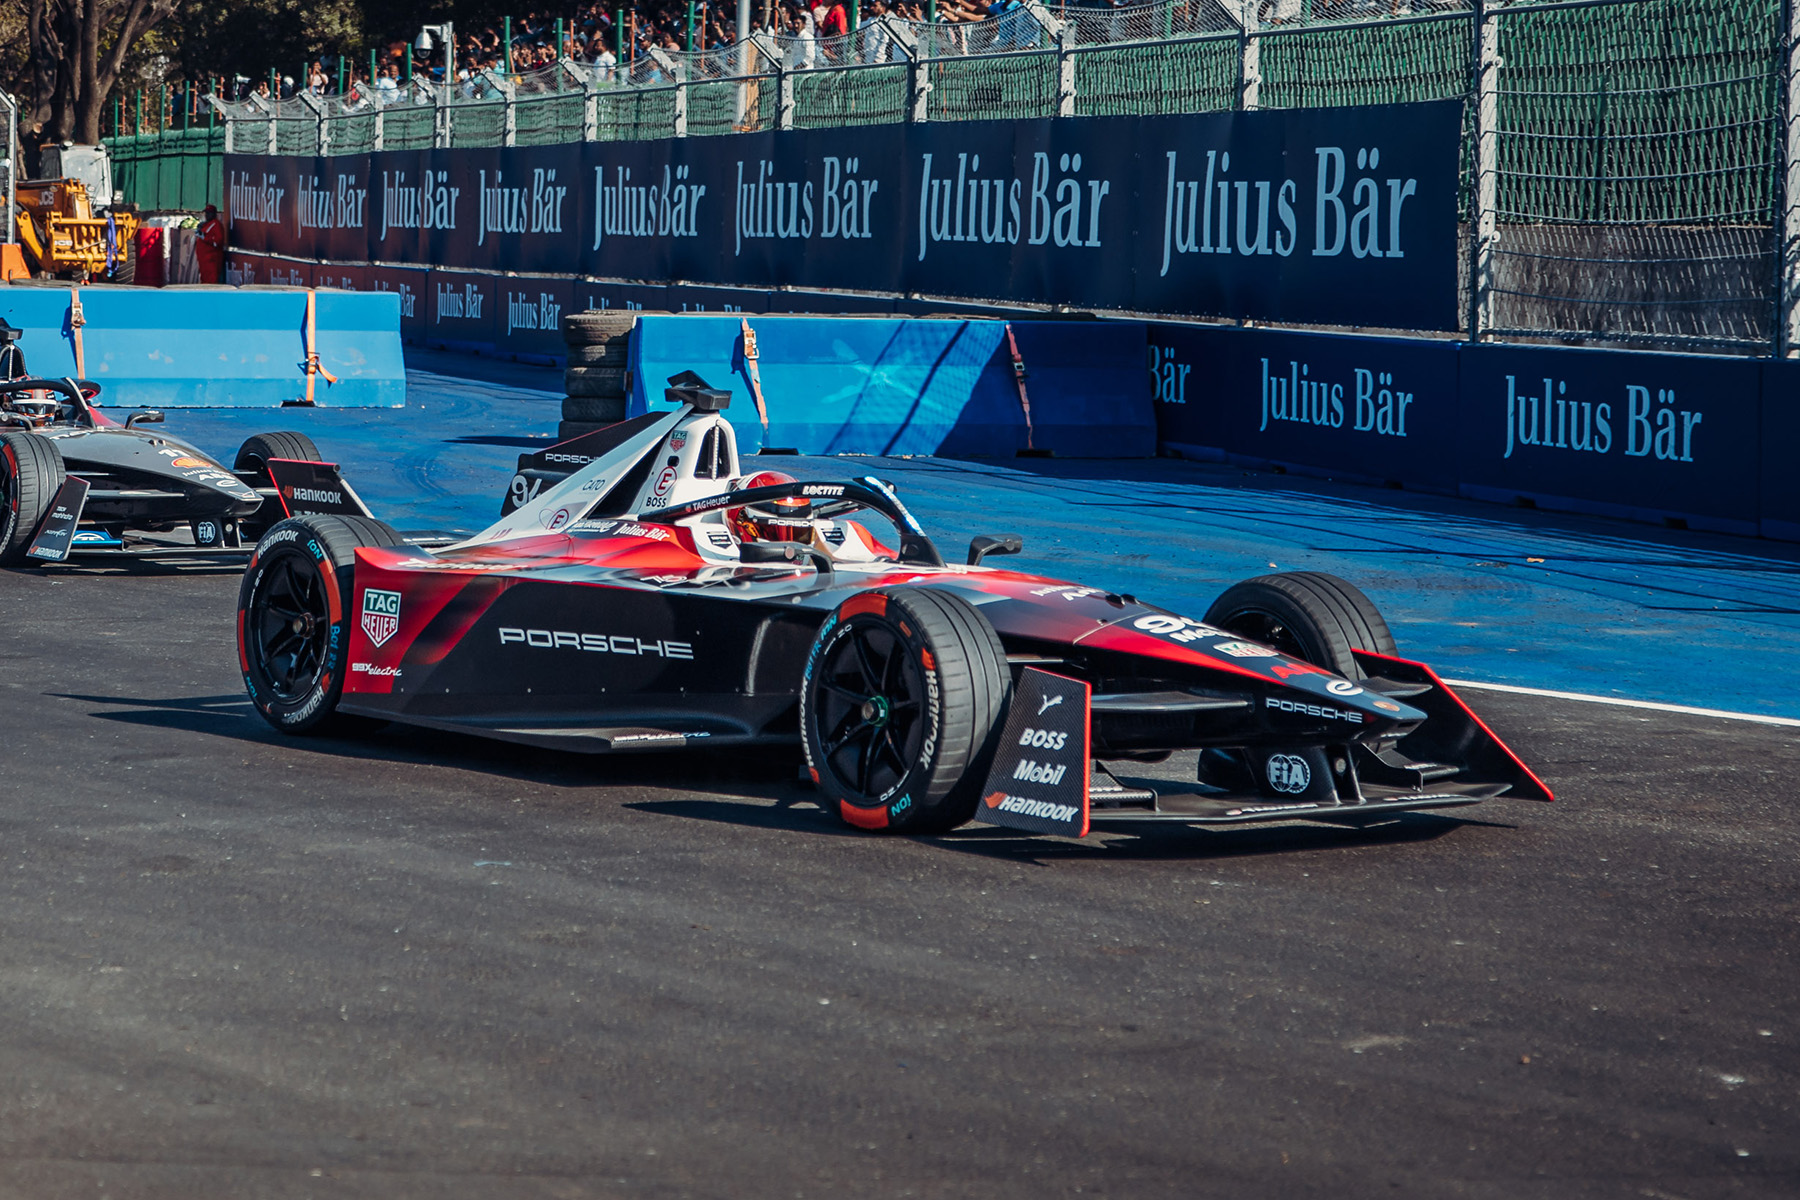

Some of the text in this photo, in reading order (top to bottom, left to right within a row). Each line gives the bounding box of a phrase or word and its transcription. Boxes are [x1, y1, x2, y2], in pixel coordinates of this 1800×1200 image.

[230, 170, 284, 230] Julius Bär
[297, 174, 366, 239] Julius Bär
[380, 169, 460, 241] Julius Bär
[478, 168, 567, 247] Julius Bär
[593, 164, 706, 251] Julius Bär
[735, 156, 878, 256] Julius Bär
[918, 151, 1110, 263] Julius Bär
[1160, 146, 1417, 278] Julius Bär
[436, 282, 484, 325] Julius Bär
[507, 291, 561, 337] Julius Bär
[1149, 344, 1191, 404] Bär
[1260, 357, 1413, 438] Julius Bär
[1504, 374, 1702, 463] Julius Bär
[646, 497, 667, 508] BOSS
[802, 485, 845, 496] LOCTITE
[612, 523, 649, 537] Julius
[645, 527, 671, 542] Bär
[367, 593, 398, 613] TAG
[364, 614, 397, 643] HEUER
[498, 627, 694, 660] PORSCHE
[352, 662, 402, 677] 99X electric
[1265, 697, 1363, 723] PORSCHE
[1019, 728, 1068, 750] BOSS
[1013, 759, 1067, 785] Mobil
